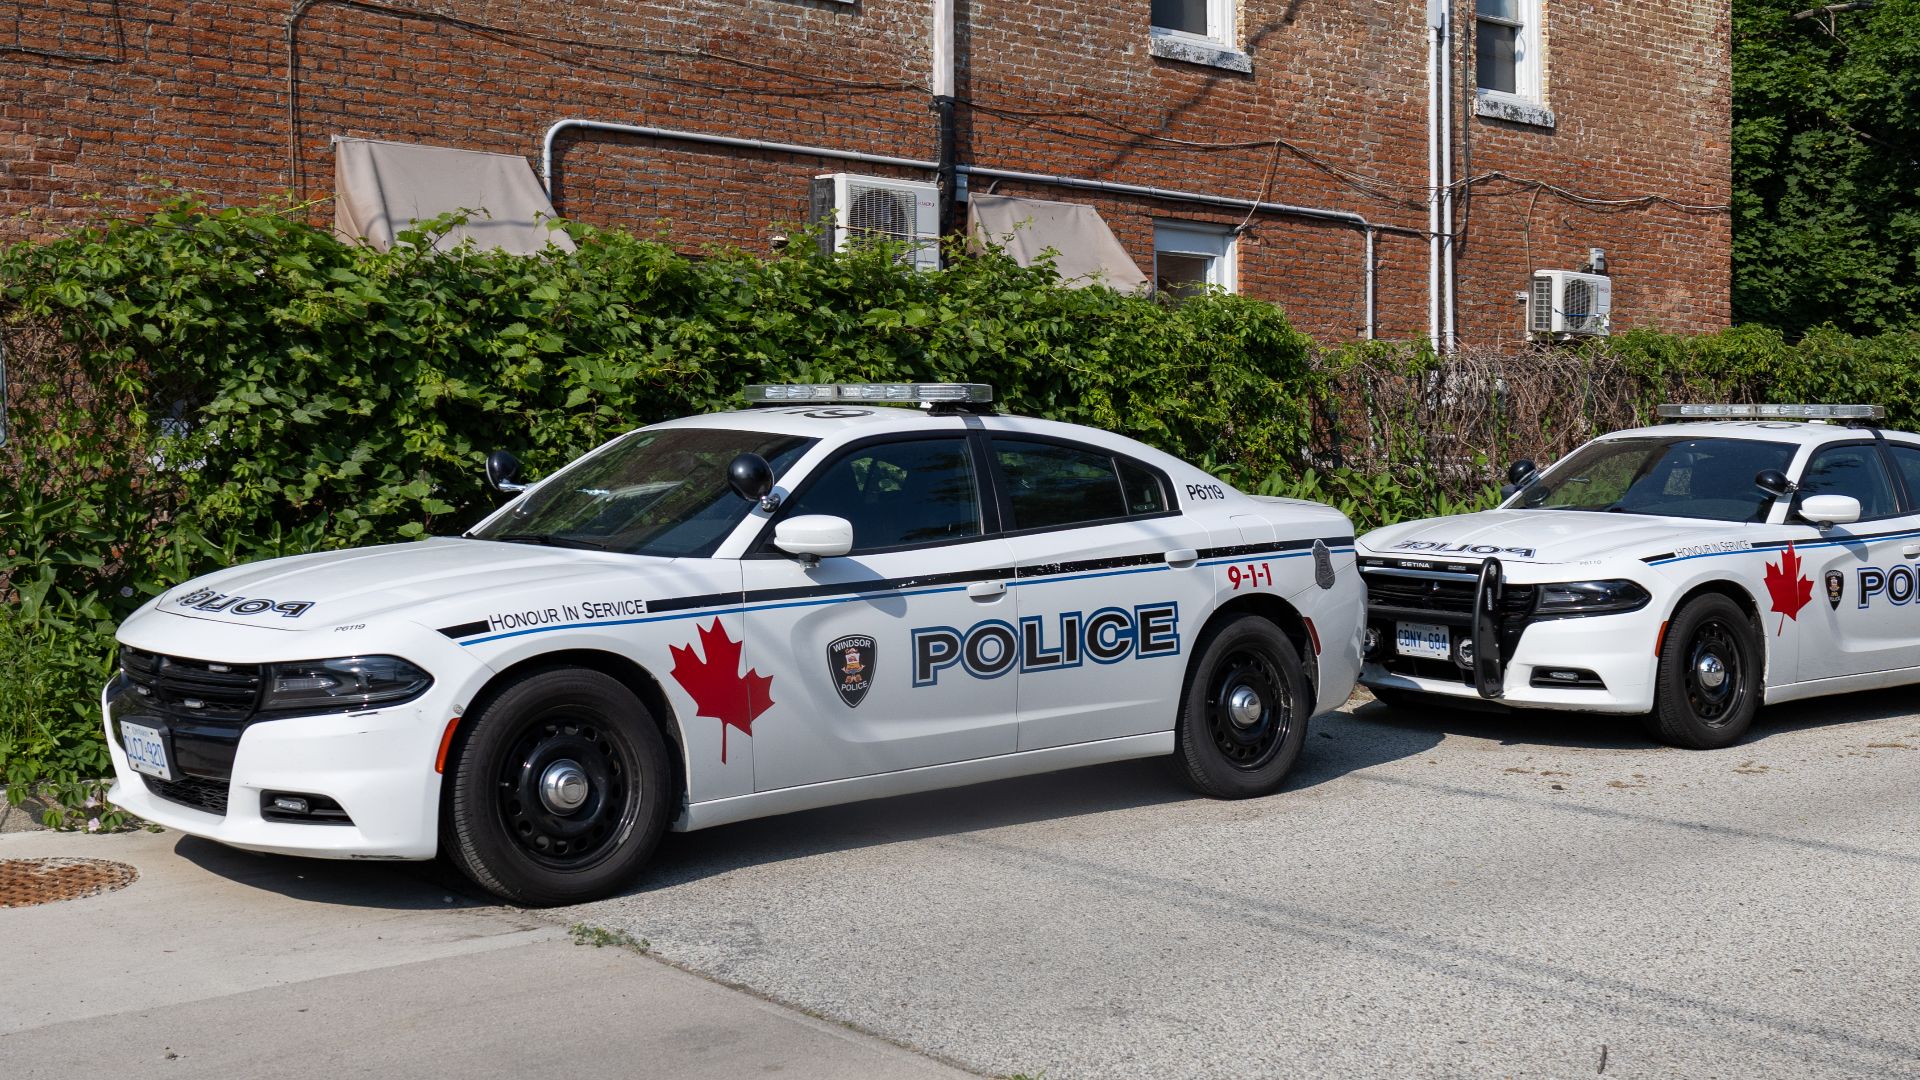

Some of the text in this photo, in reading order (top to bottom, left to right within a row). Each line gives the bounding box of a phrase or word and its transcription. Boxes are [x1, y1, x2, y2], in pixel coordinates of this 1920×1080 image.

[1186, 484, 1225, 501] P6119
[1675, 545, 1711, 557] HONOUR
[1720, 540, 1750, 551] SERVICE
[1401, 561, 1431, 569] SETINA
[1227, 562, 1272, 590] 9-1-1
[1857, 564, 1920, 609] PO
[489, 599, 645, 631] HONOUR IN SERVICE
[334, 623, 366, 633] P6119
[832, 639, 871, 653] WINDSOR
[911, 600, 1181, 688] POLICE
[841, 680, 868, 692] POLICE
